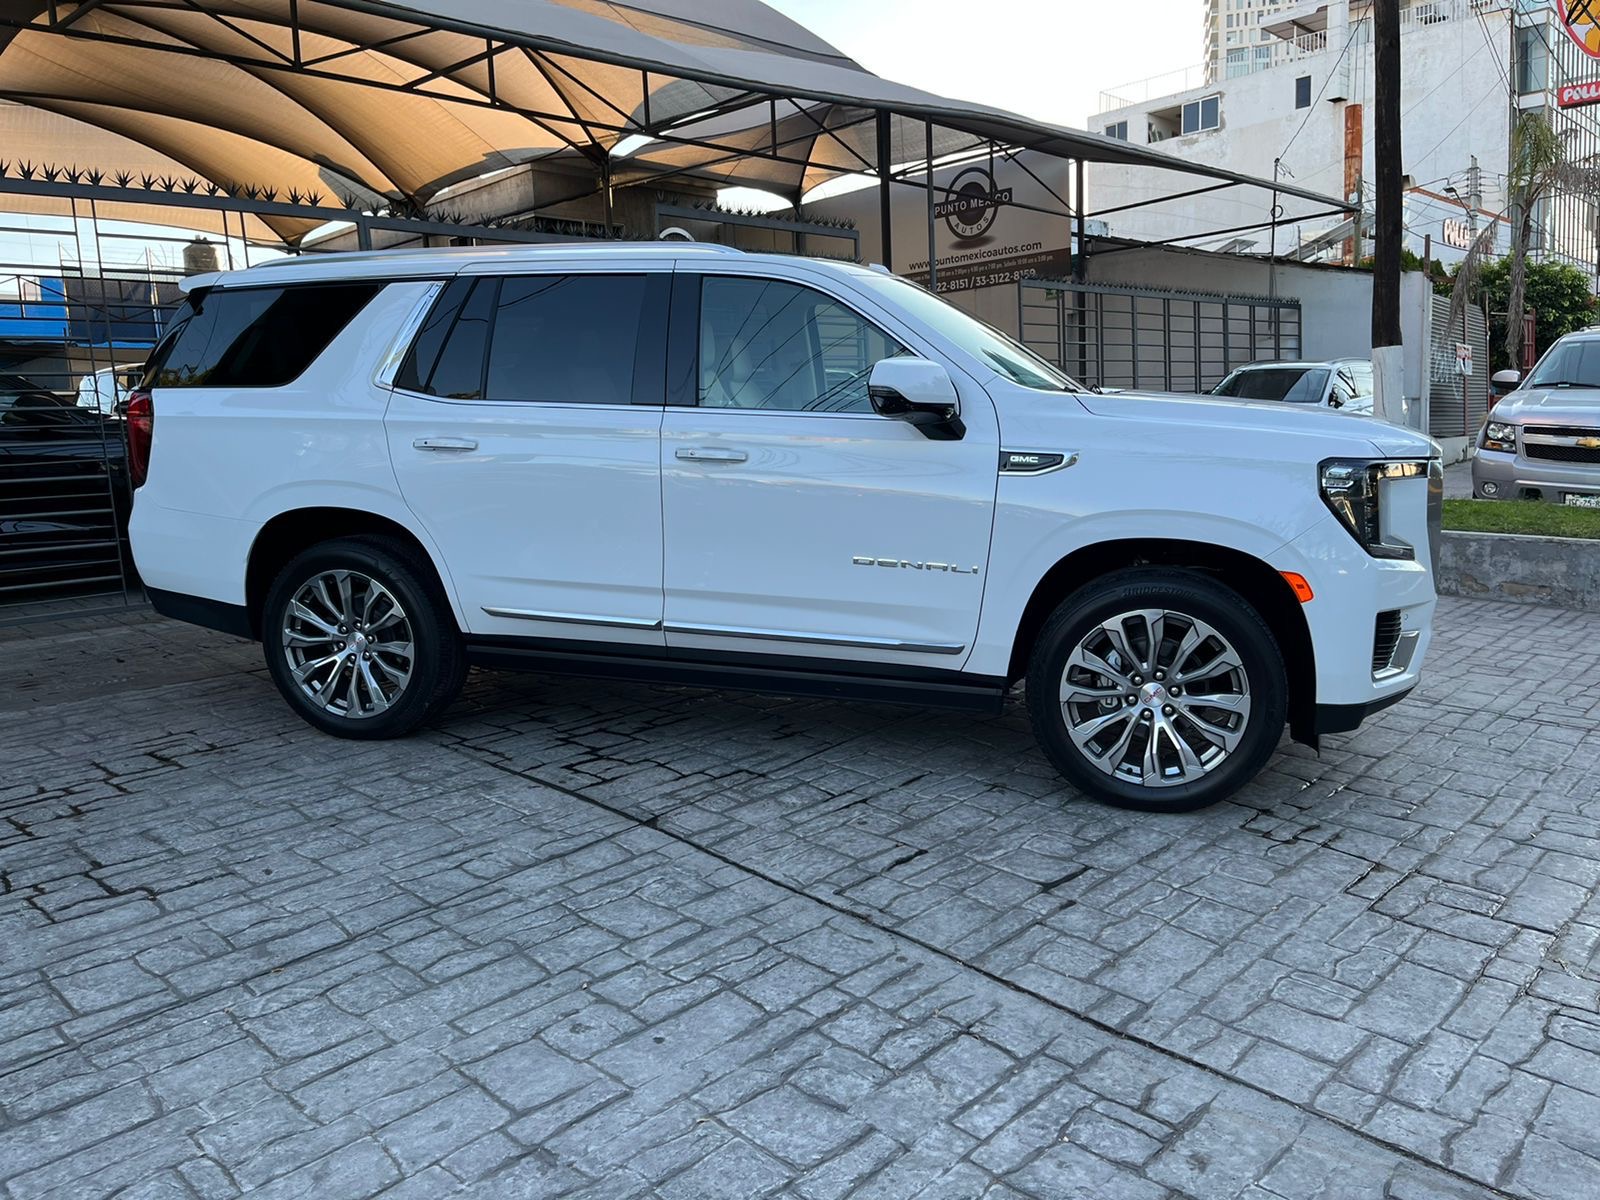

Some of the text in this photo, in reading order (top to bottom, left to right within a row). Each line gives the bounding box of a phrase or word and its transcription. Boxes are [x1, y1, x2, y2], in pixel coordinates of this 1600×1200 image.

[1563, 84, 1600, 102] POLL
[934, 200, 967, 216] PUNTO
[954, 216, 990, 234] AUTOS
[909, 242, 1042, 271] wwwpuntomexicoautos.com
[1010, 455, 1039, 463] GMC
[853, 556, 978, 574] DENALI
[1143, 686, 1163, 704] GMC
